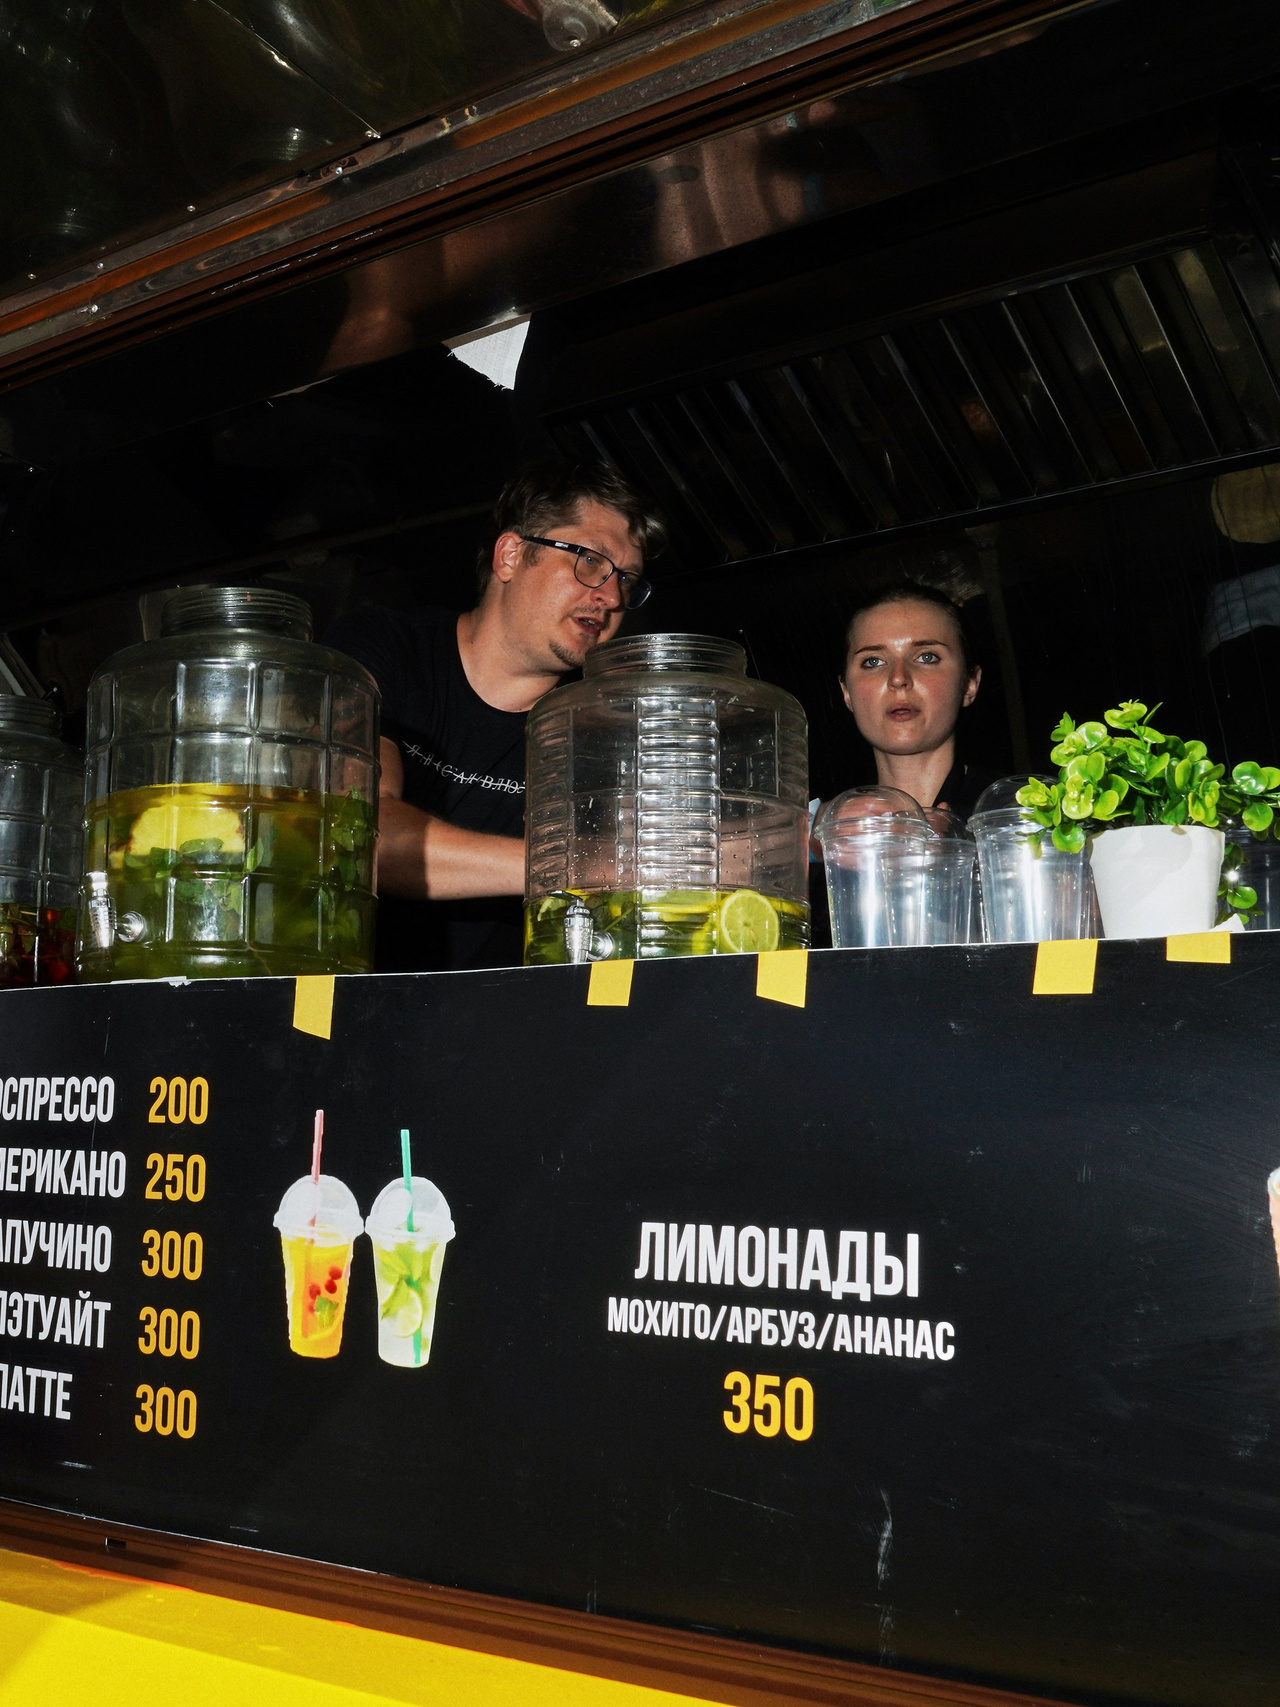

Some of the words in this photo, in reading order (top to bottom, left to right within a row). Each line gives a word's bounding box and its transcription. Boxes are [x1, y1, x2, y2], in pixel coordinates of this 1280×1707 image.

[148, 1076, 210, 1124] 200
[145, 1153, 207, 1202] 250
[142, 1229, 204, 1280] 300
[634, 1222, 920, 1302] ЛИМОНАДЫ
[138, 1306, 200, 1359] 300
[608, 1297, 955, 1361] МОХИТО/АРБУЗ/АНАНАС
[135, 1383, 197, 1439] 300
[723, 1371, 815, 1441] 350
